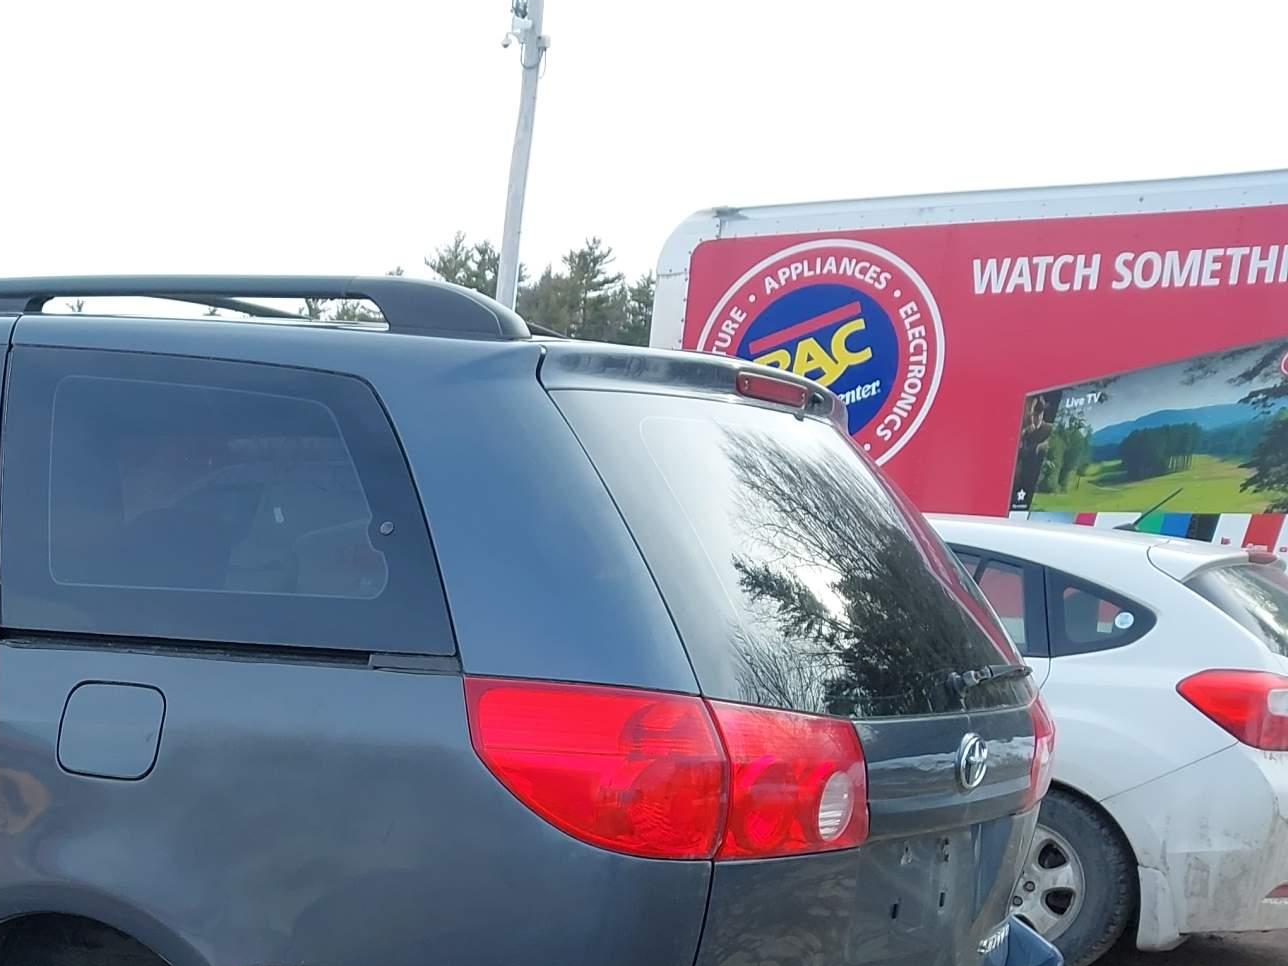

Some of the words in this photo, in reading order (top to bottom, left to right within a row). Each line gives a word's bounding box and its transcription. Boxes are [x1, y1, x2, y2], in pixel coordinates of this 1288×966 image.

[765, 256, 892, 295] APPLIANCES
[972, 253, 1101, 295] WATCH
[876, 301, 928, 441] ELECTRONICS
[1066, 397, 1084, 409] Live
[1086, 391, 1103, 404] TV
